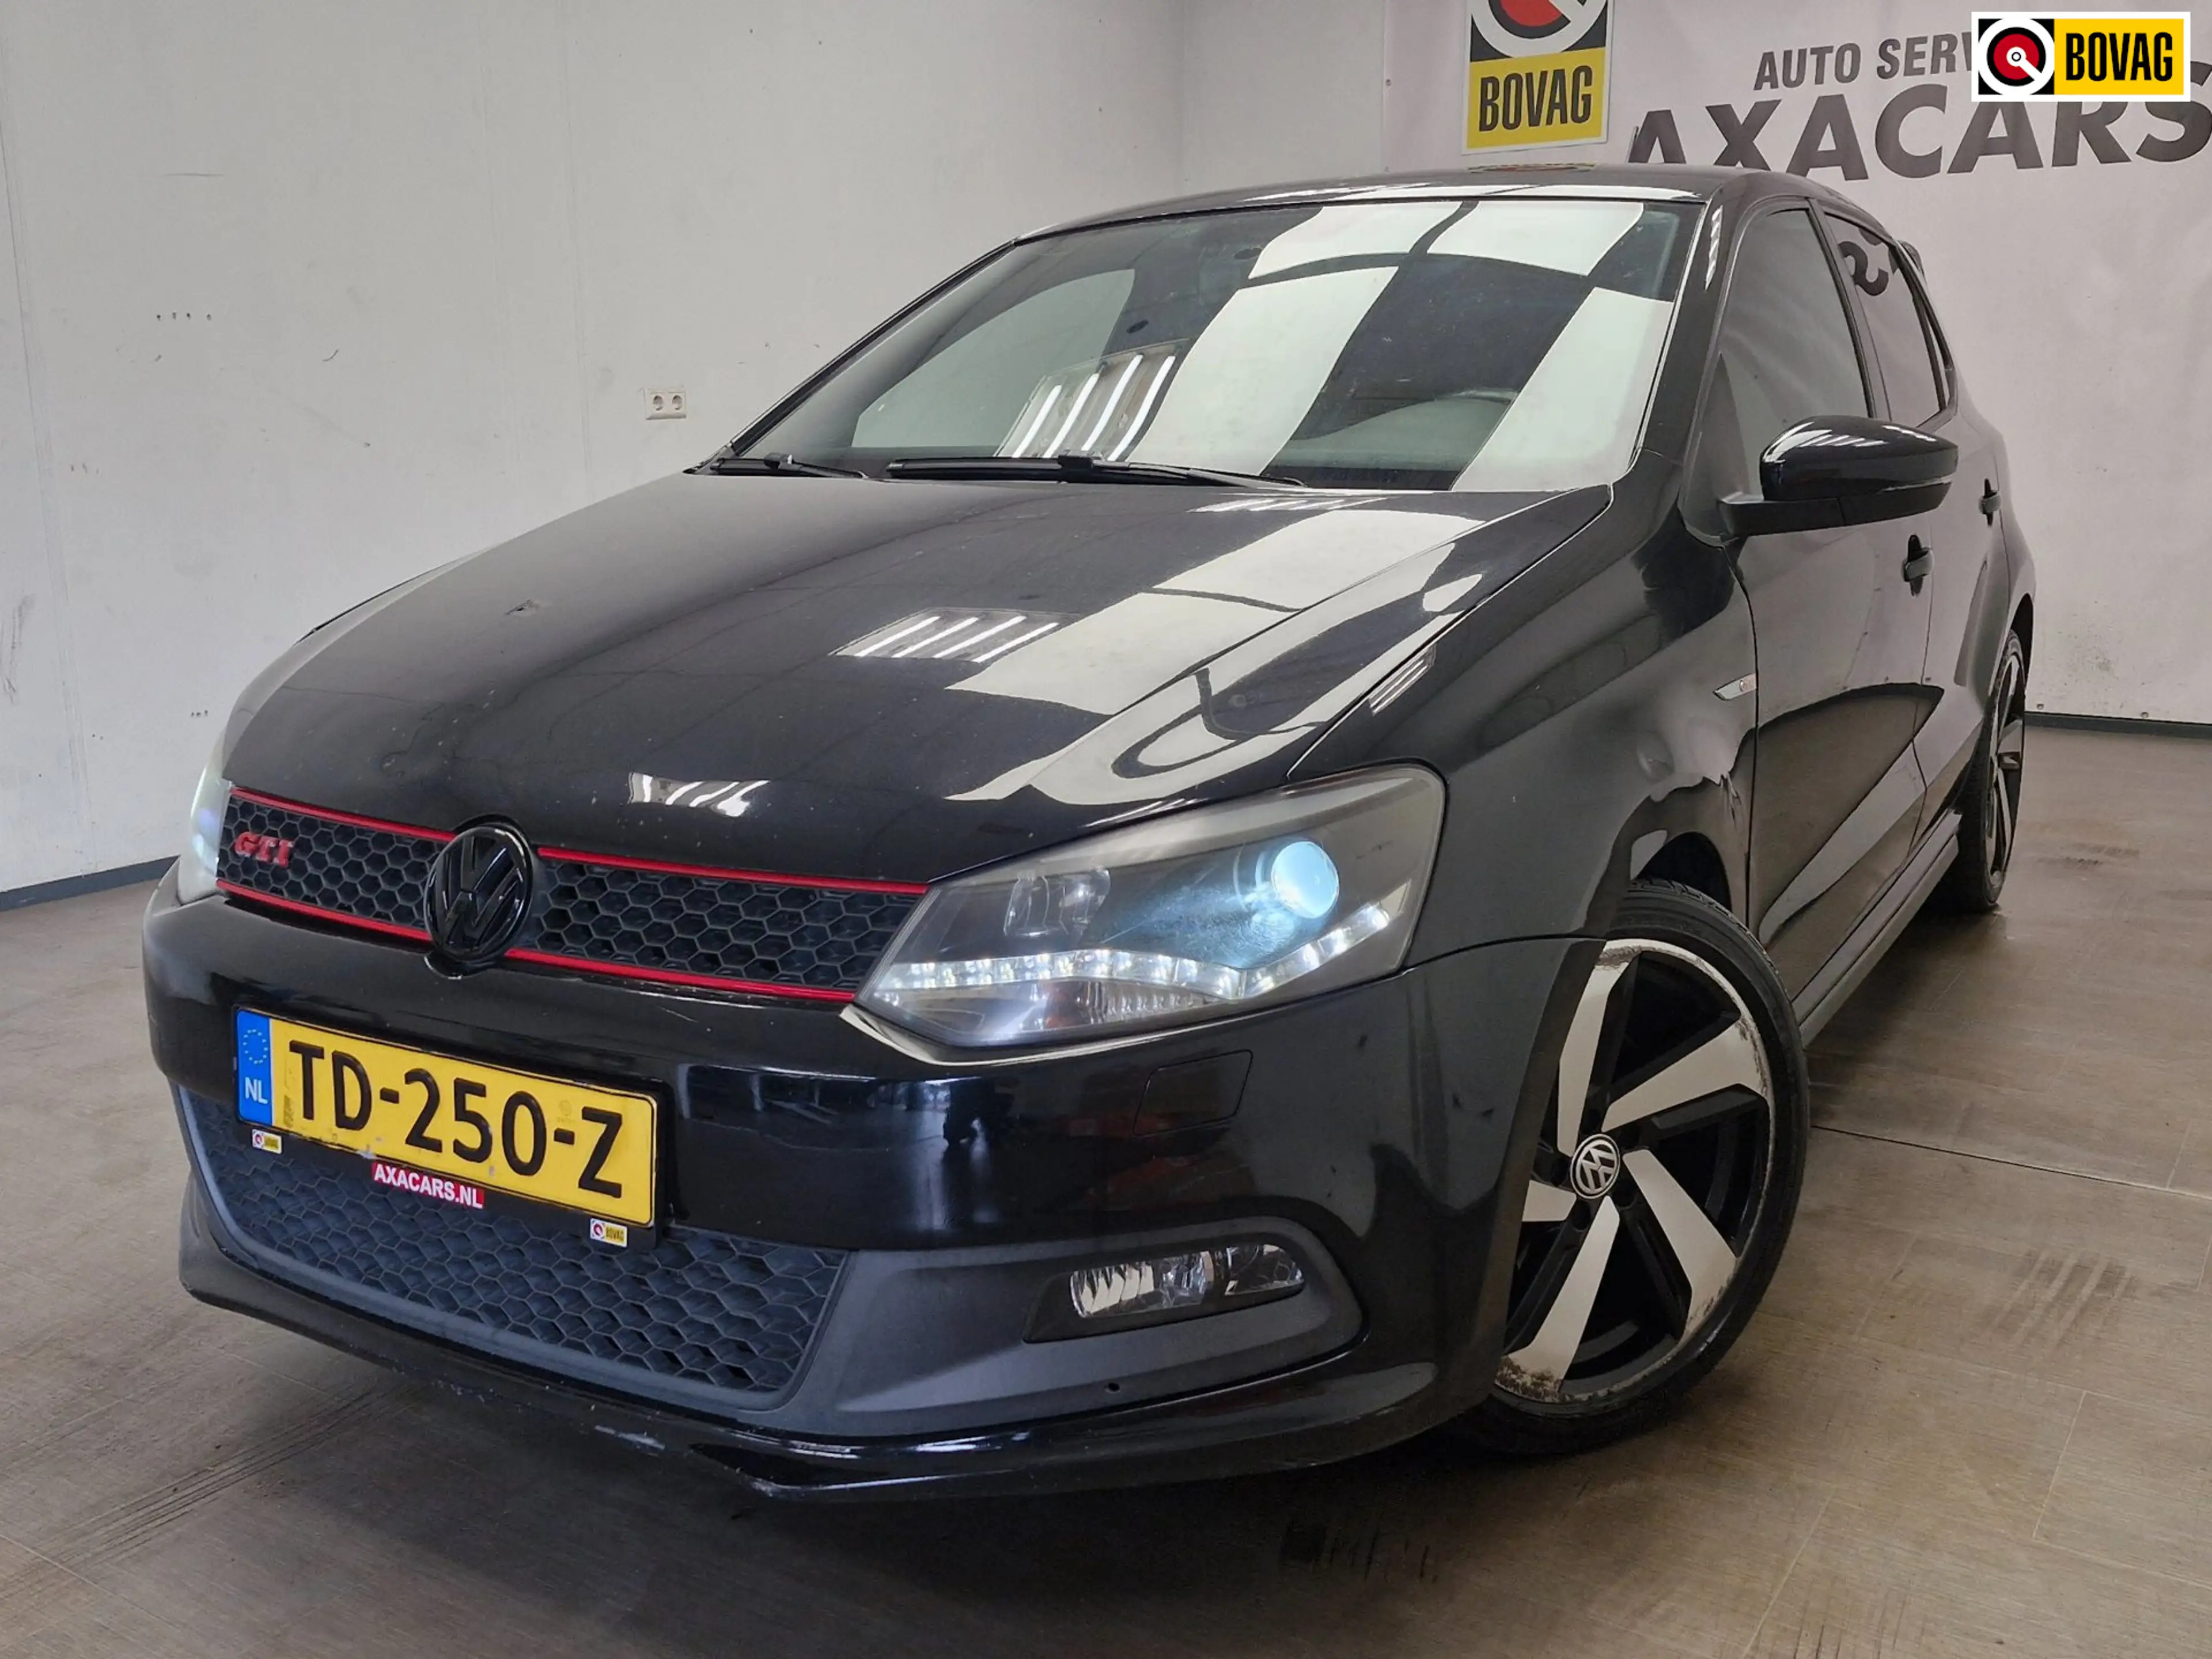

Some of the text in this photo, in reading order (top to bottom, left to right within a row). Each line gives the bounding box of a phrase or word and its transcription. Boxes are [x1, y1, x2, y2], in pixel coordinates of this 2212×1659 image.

[1753, 41, 1861, 90] AUTO
[1479, 65, 1593, 132] BOVAG
[234, 831, 295, 868] GTI
[245, 1077, 268, 1104] NL
[289, 1039, 623, 1199] TD-250-Z
[374, 1163, 483, 1209] AXACARS.NL
